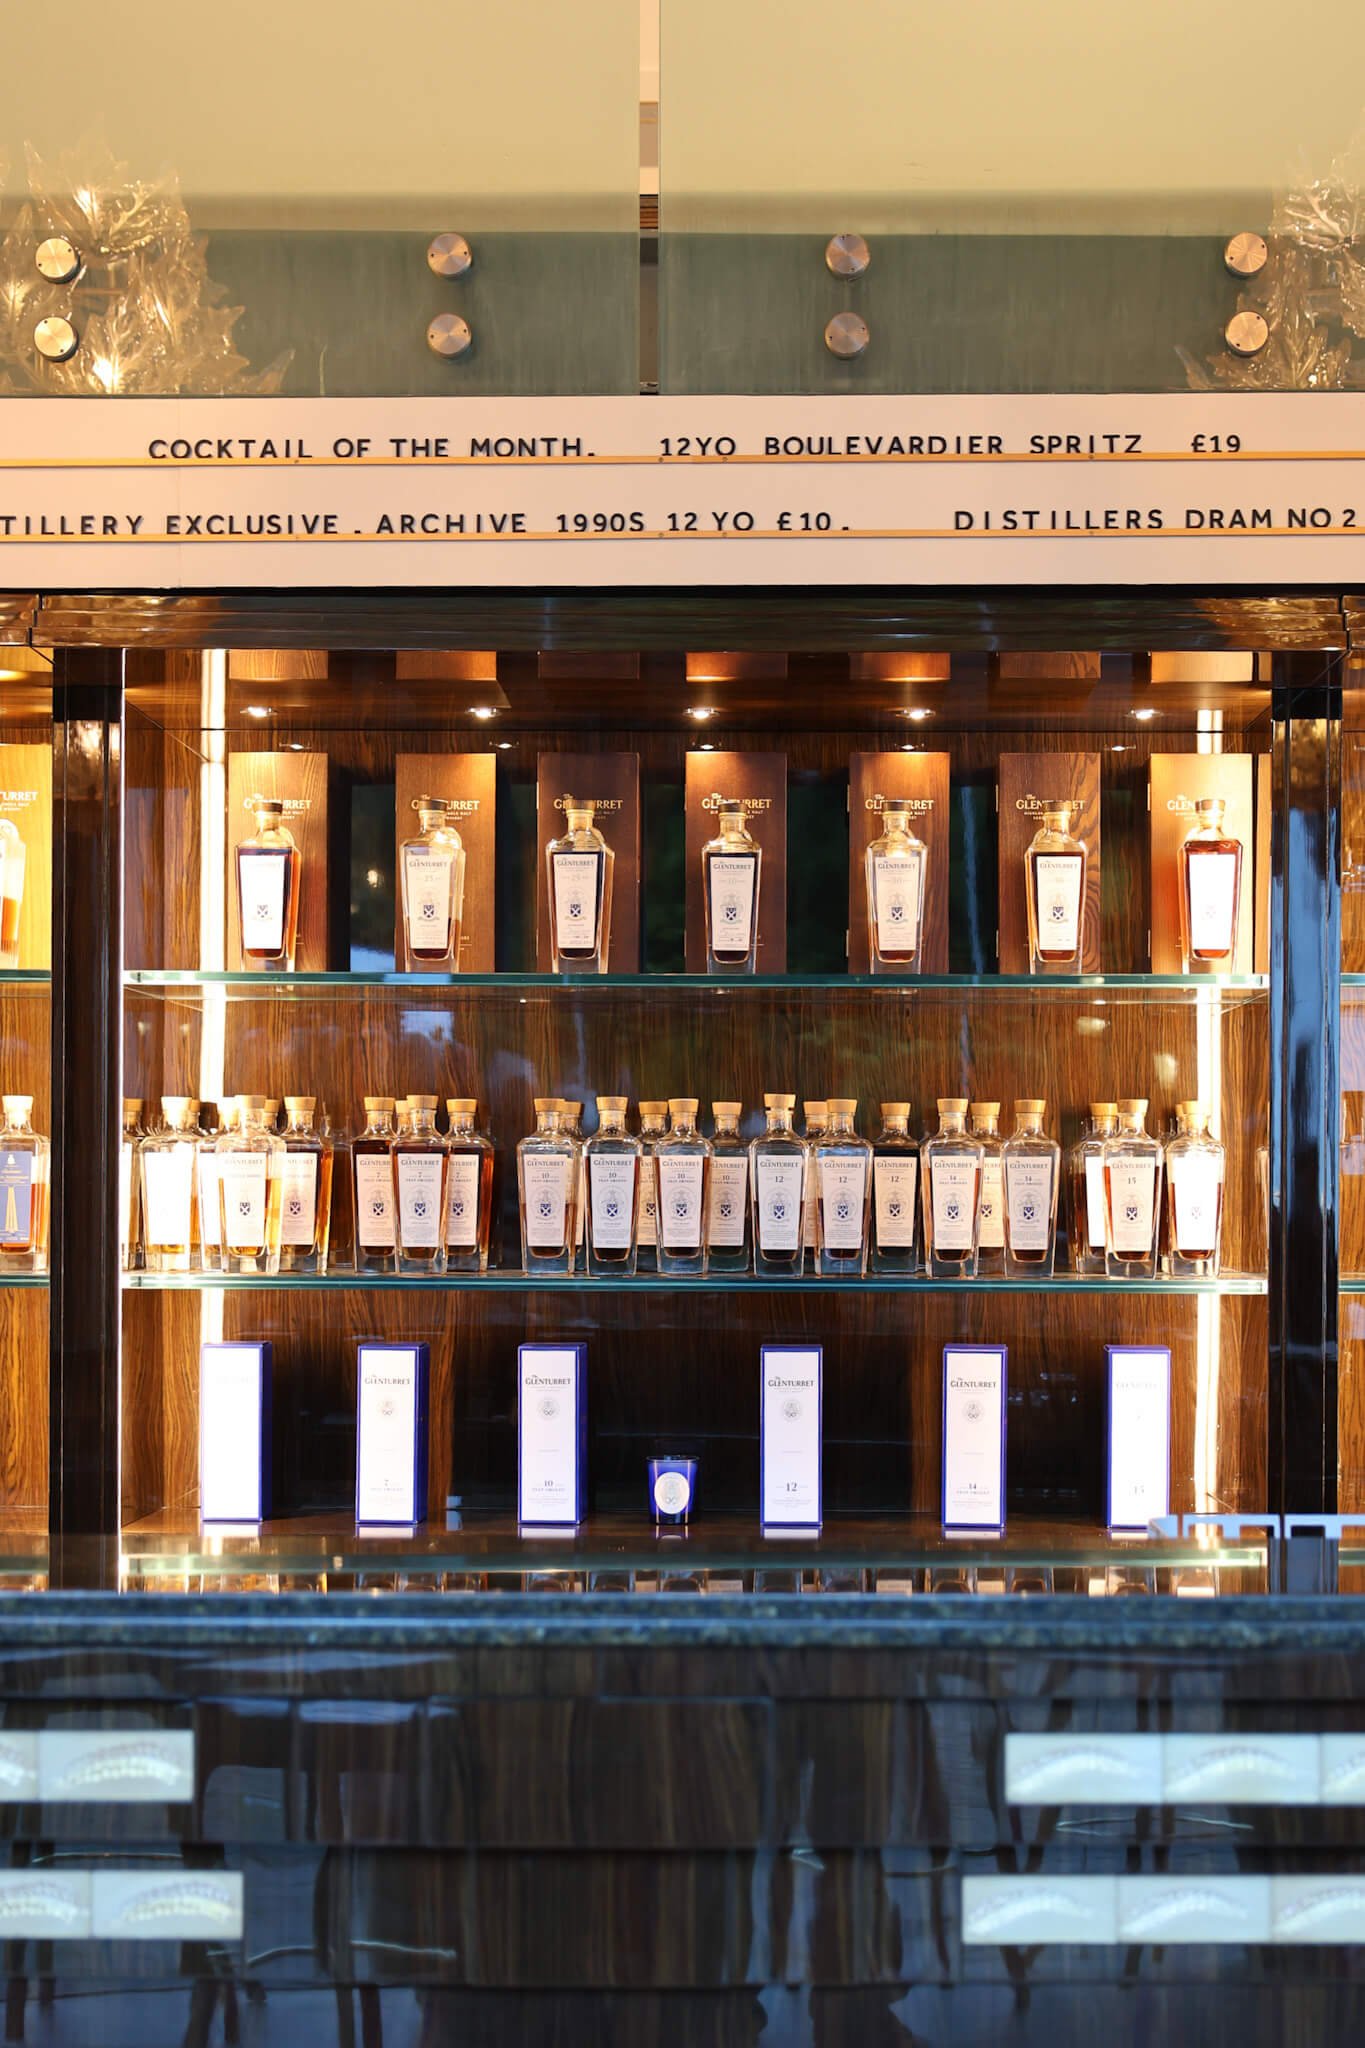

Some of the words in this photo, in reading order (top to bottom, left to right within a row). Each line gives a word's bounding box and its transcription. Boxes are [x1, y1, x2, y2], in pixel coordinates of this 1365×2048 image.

[148, 439, 313, 459] COCKTAIL
[333, 438, 372, 459] OF
[389, 438, 449, 458] THE
[470, 437, 596, 458] MONTH.
[765, 436, 1003, 456] BOULEVARDIER
[1029, 434, 1142, 454] SPRITZ
[1191, 434, 1242, 454] £19
[0, 515, 143, 536] TILLERY
[166, 514, 339, 535] EXCLUSIVE
[376, 513, 527, 535] ARCHIVE
[557, 511, 645, 534] 1990S
[954, 509, 1164, 531] DISTILLERS
[1185, 508, 1273, 530] DRAM
[1127, 1177, 1137, 1185] 15
[768, 1379, 814, 1387] GLENTURRET
[950, 1380, 996, 1388] GLENTURRET
[786, 1482, 798, 1492] 12
